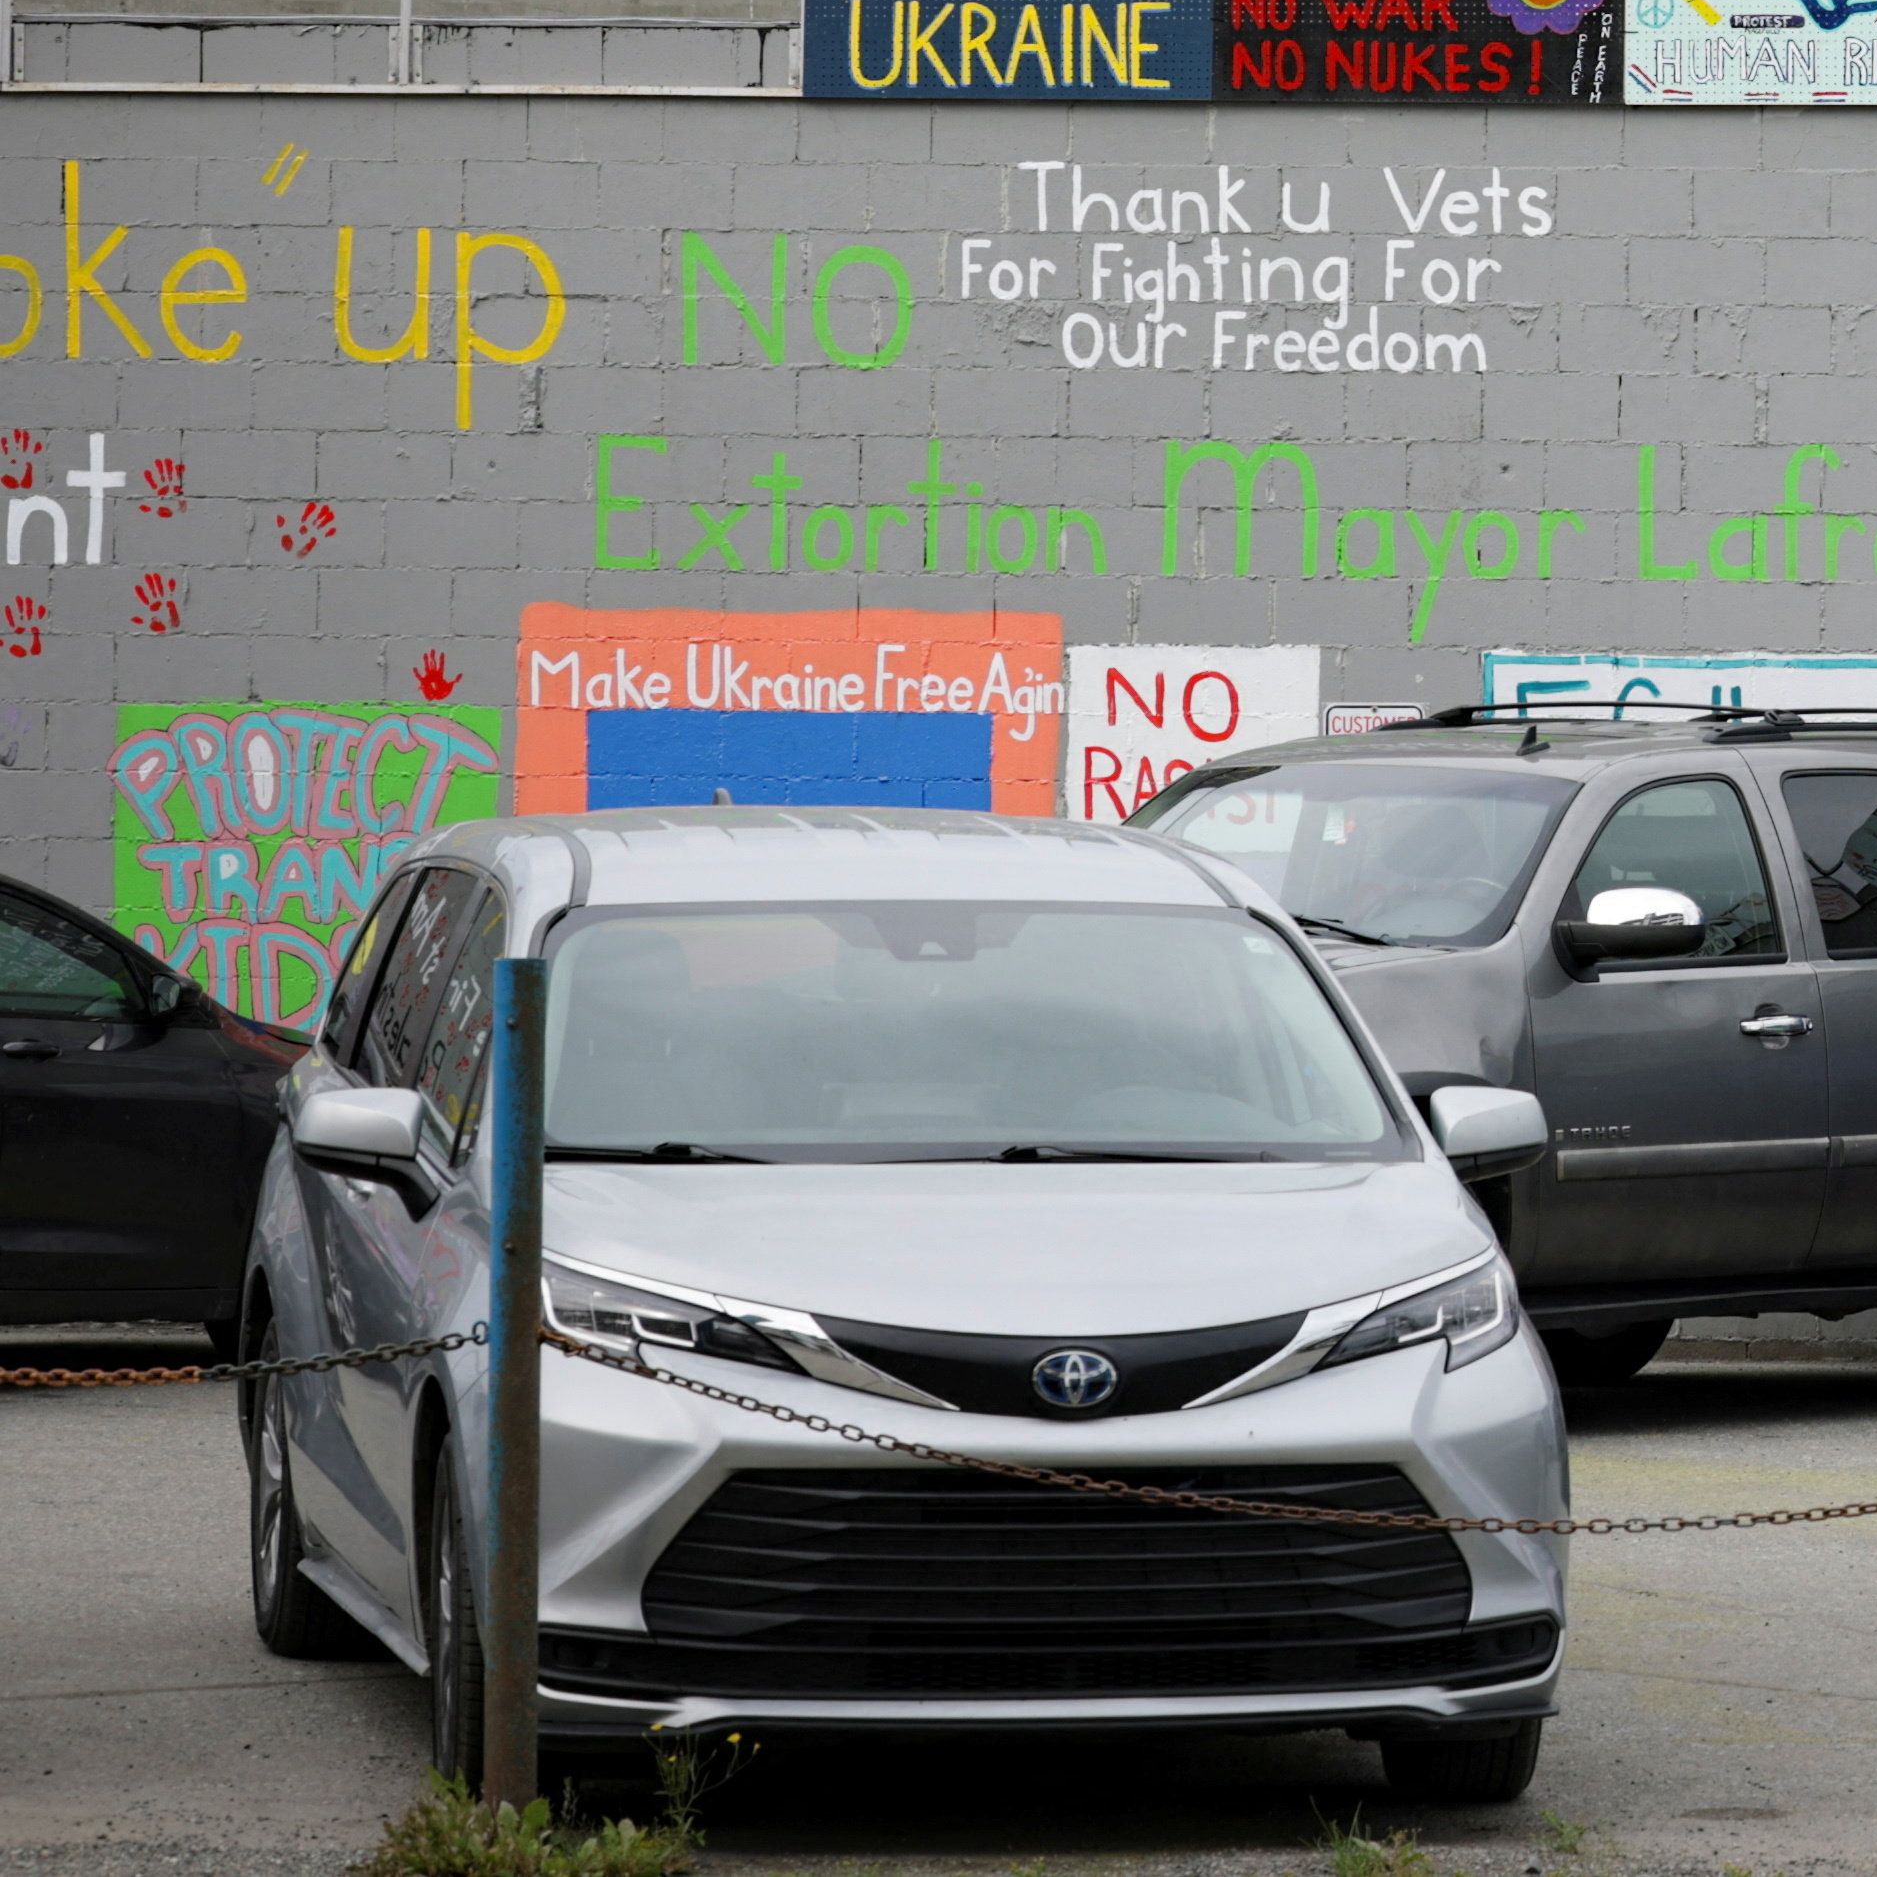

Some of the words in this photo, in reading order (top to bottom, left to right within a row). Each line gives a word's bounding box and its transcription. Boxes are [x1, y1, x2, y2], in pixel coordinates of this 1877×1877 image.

[1601, 13, 1613, 38] ON
[1733, 15, 1793, 28] PROTEST
[1231, 39, 1304, 92] NO
[1571, 34, 1588, 95] PEACE
[1589, 45, 1607, 103] EARTH
[1656, 35, 1816, 85] HUMAN
[1018, 160, 1252, 233] Thank
[1383, 166, 1554, 237] Vets
[0, 159, 248, 363] oke
[333, 225, 567, 431] up
[961, 238, 1057, 301] For
[1091, 236, 1350, 330] Fighting
[1385, 239, 1502, 306] For
[1061, 312, 1187, 370] Our
[1212, 305, 1488, 374] Freedom
[7, 432, 127, 565] nt
[595, 433, 1109, 576] Extortion
[530, 647, 672, 710] Make
[686, 643, 865, 713] Ukraine
[875, 644, 975, 713] Free
[1106, 666, 1240, 743] NO
[106, 707, 500, 841] PROTECT
[134, 918, 357, 1036] KID
[1570, 1126, 1631, 1139] TAHOE
